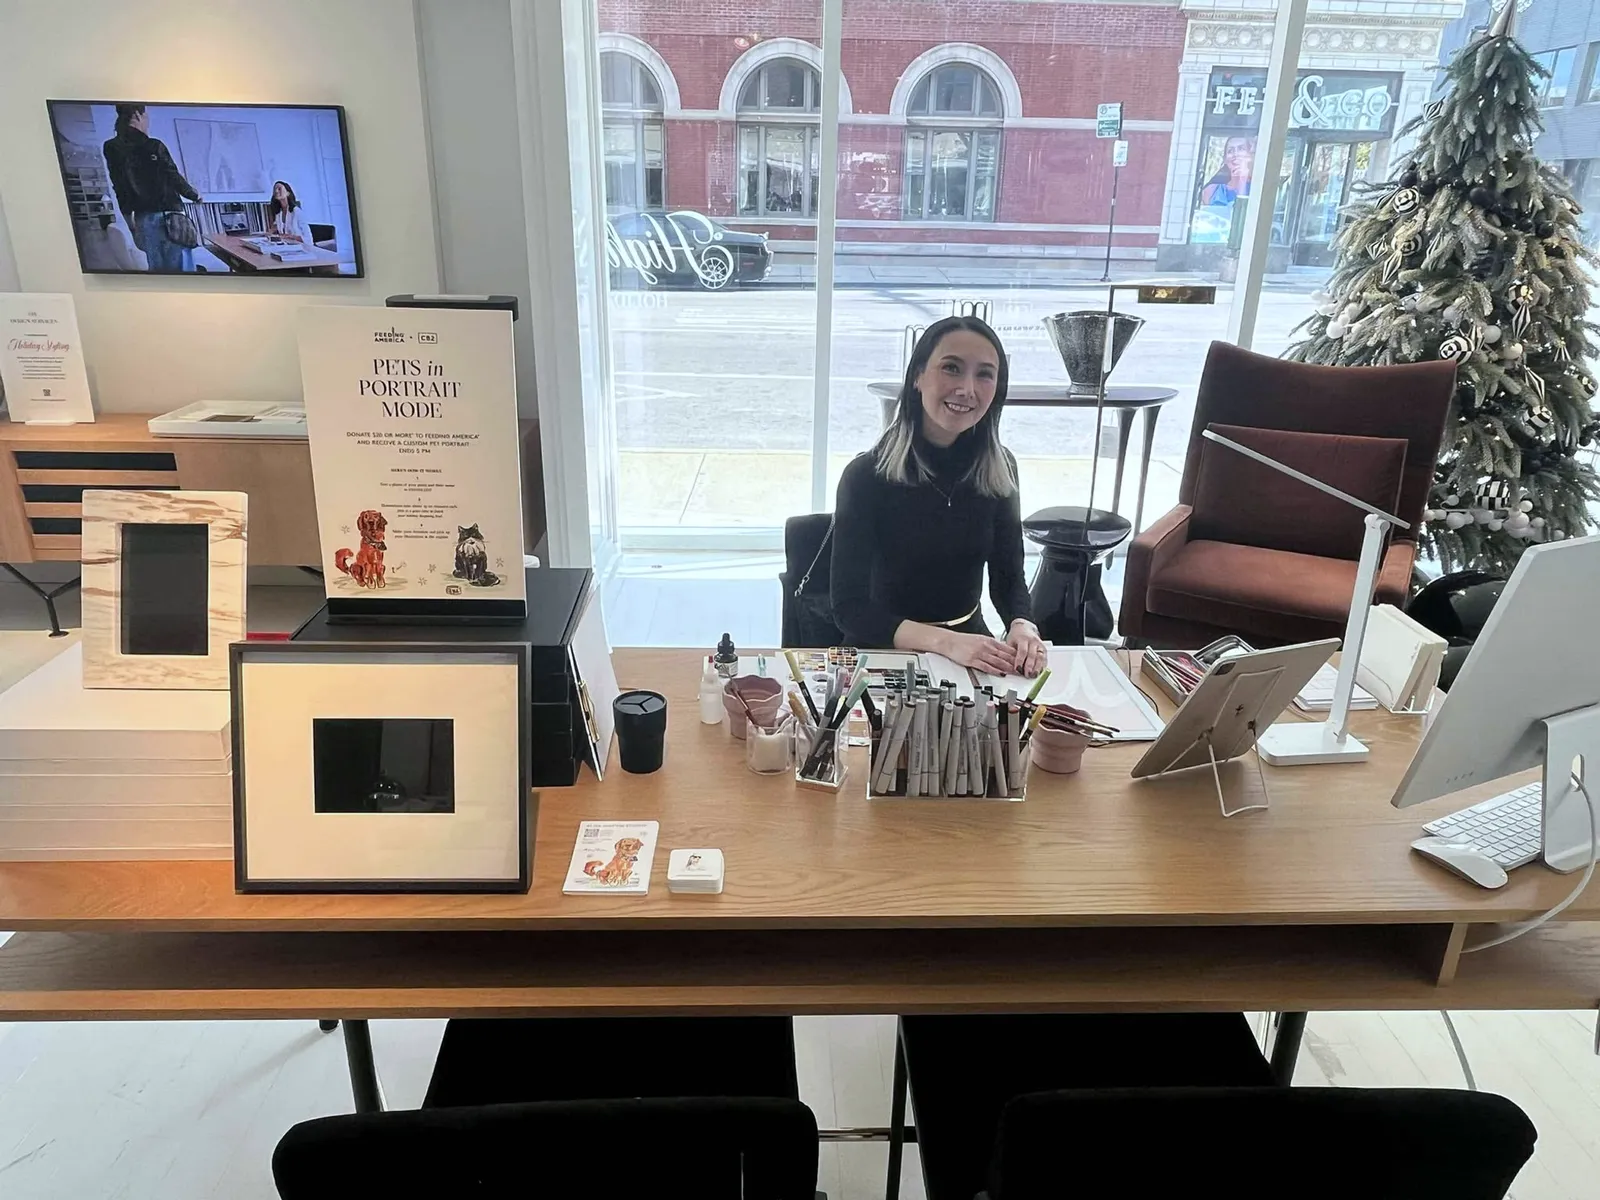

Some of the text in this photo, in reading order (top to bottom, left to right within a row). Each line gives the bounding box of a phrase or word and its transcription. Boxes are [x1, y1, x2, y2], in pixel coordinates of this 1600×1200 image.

[1213, 86, 1266, 115] FE
[374, 329, 404, 337] FEEDING
[373, 359, 444, 376] PETS in
[359, 380, 461, 398] PORTRAIT
[382, 402, 442, 418] MODE
